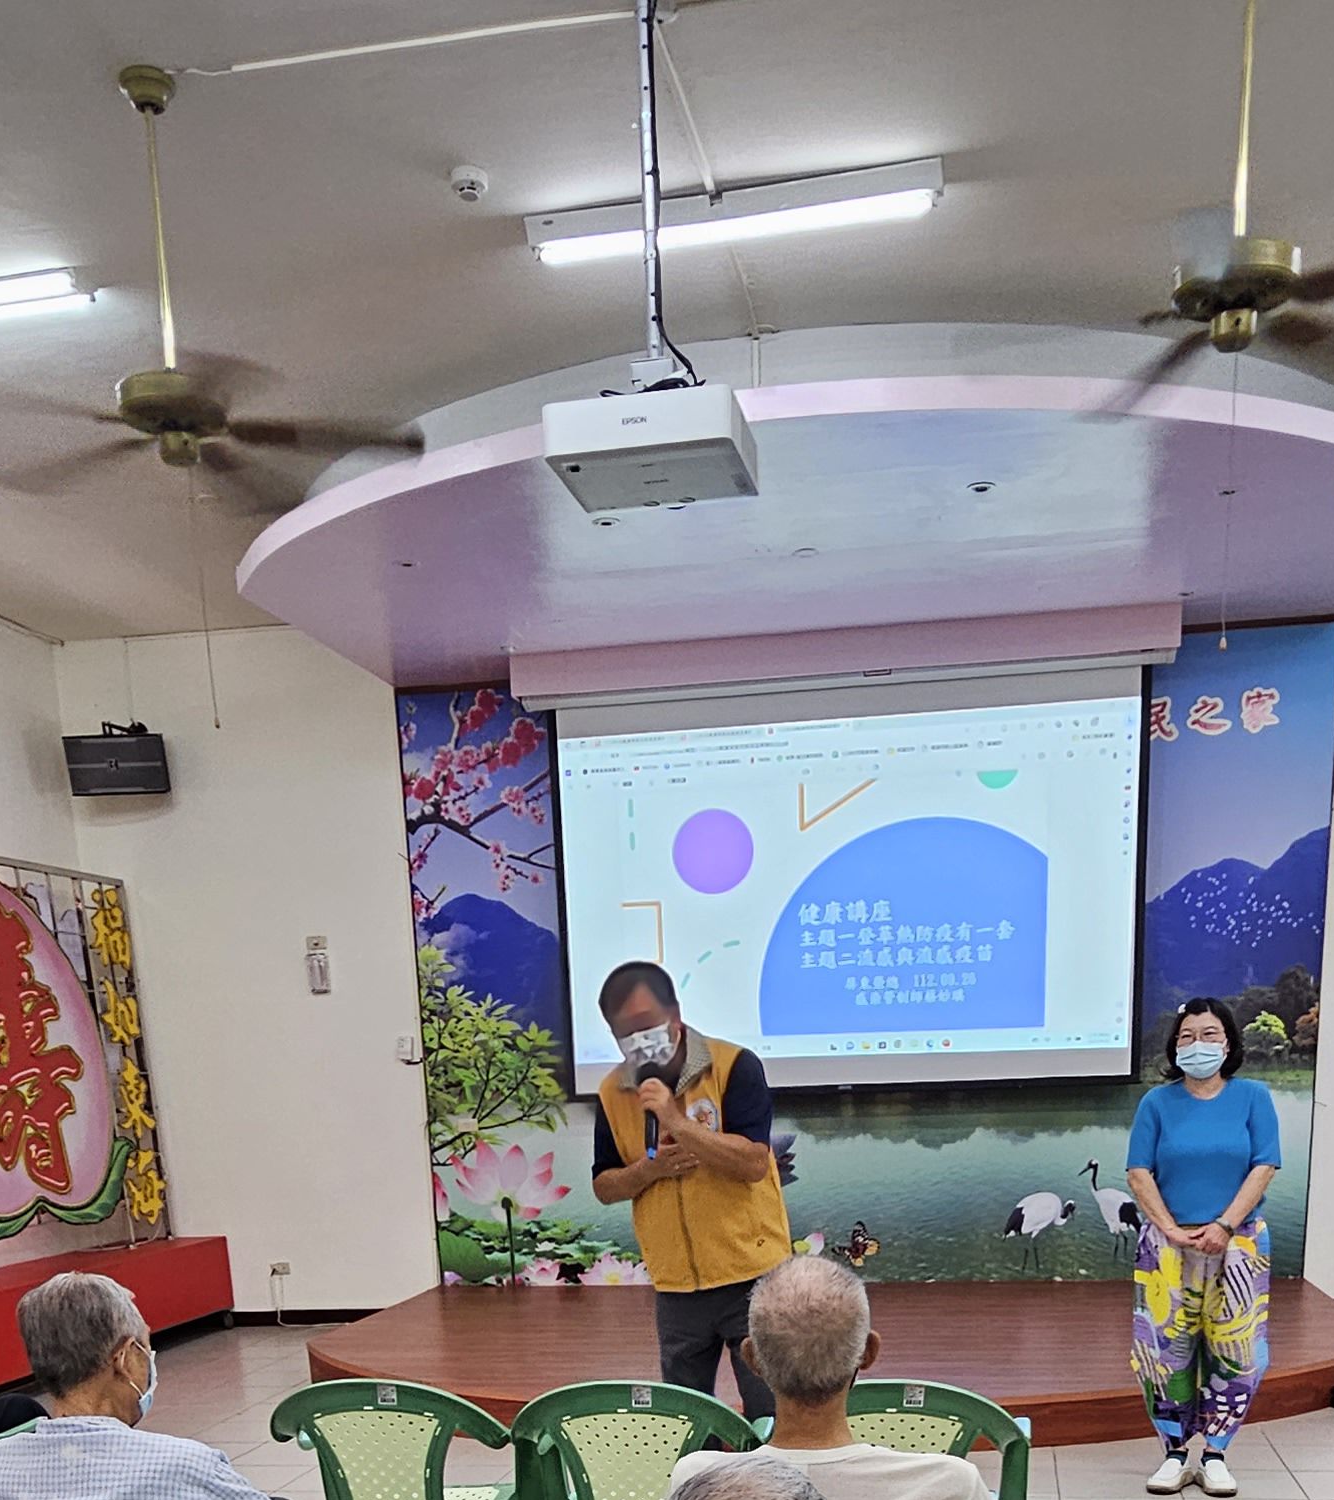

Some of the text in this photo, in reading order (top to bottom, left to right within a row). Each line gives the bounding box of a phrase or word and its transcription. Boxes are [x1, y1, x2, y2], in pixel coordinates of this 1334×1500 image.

[621, 415, 648, 426] EPSON
[1150, 687, 1280, 741] 民之家
[797, 899, 893, 926] 健康講座
[90, 887, 168, 1226] 福如東海
